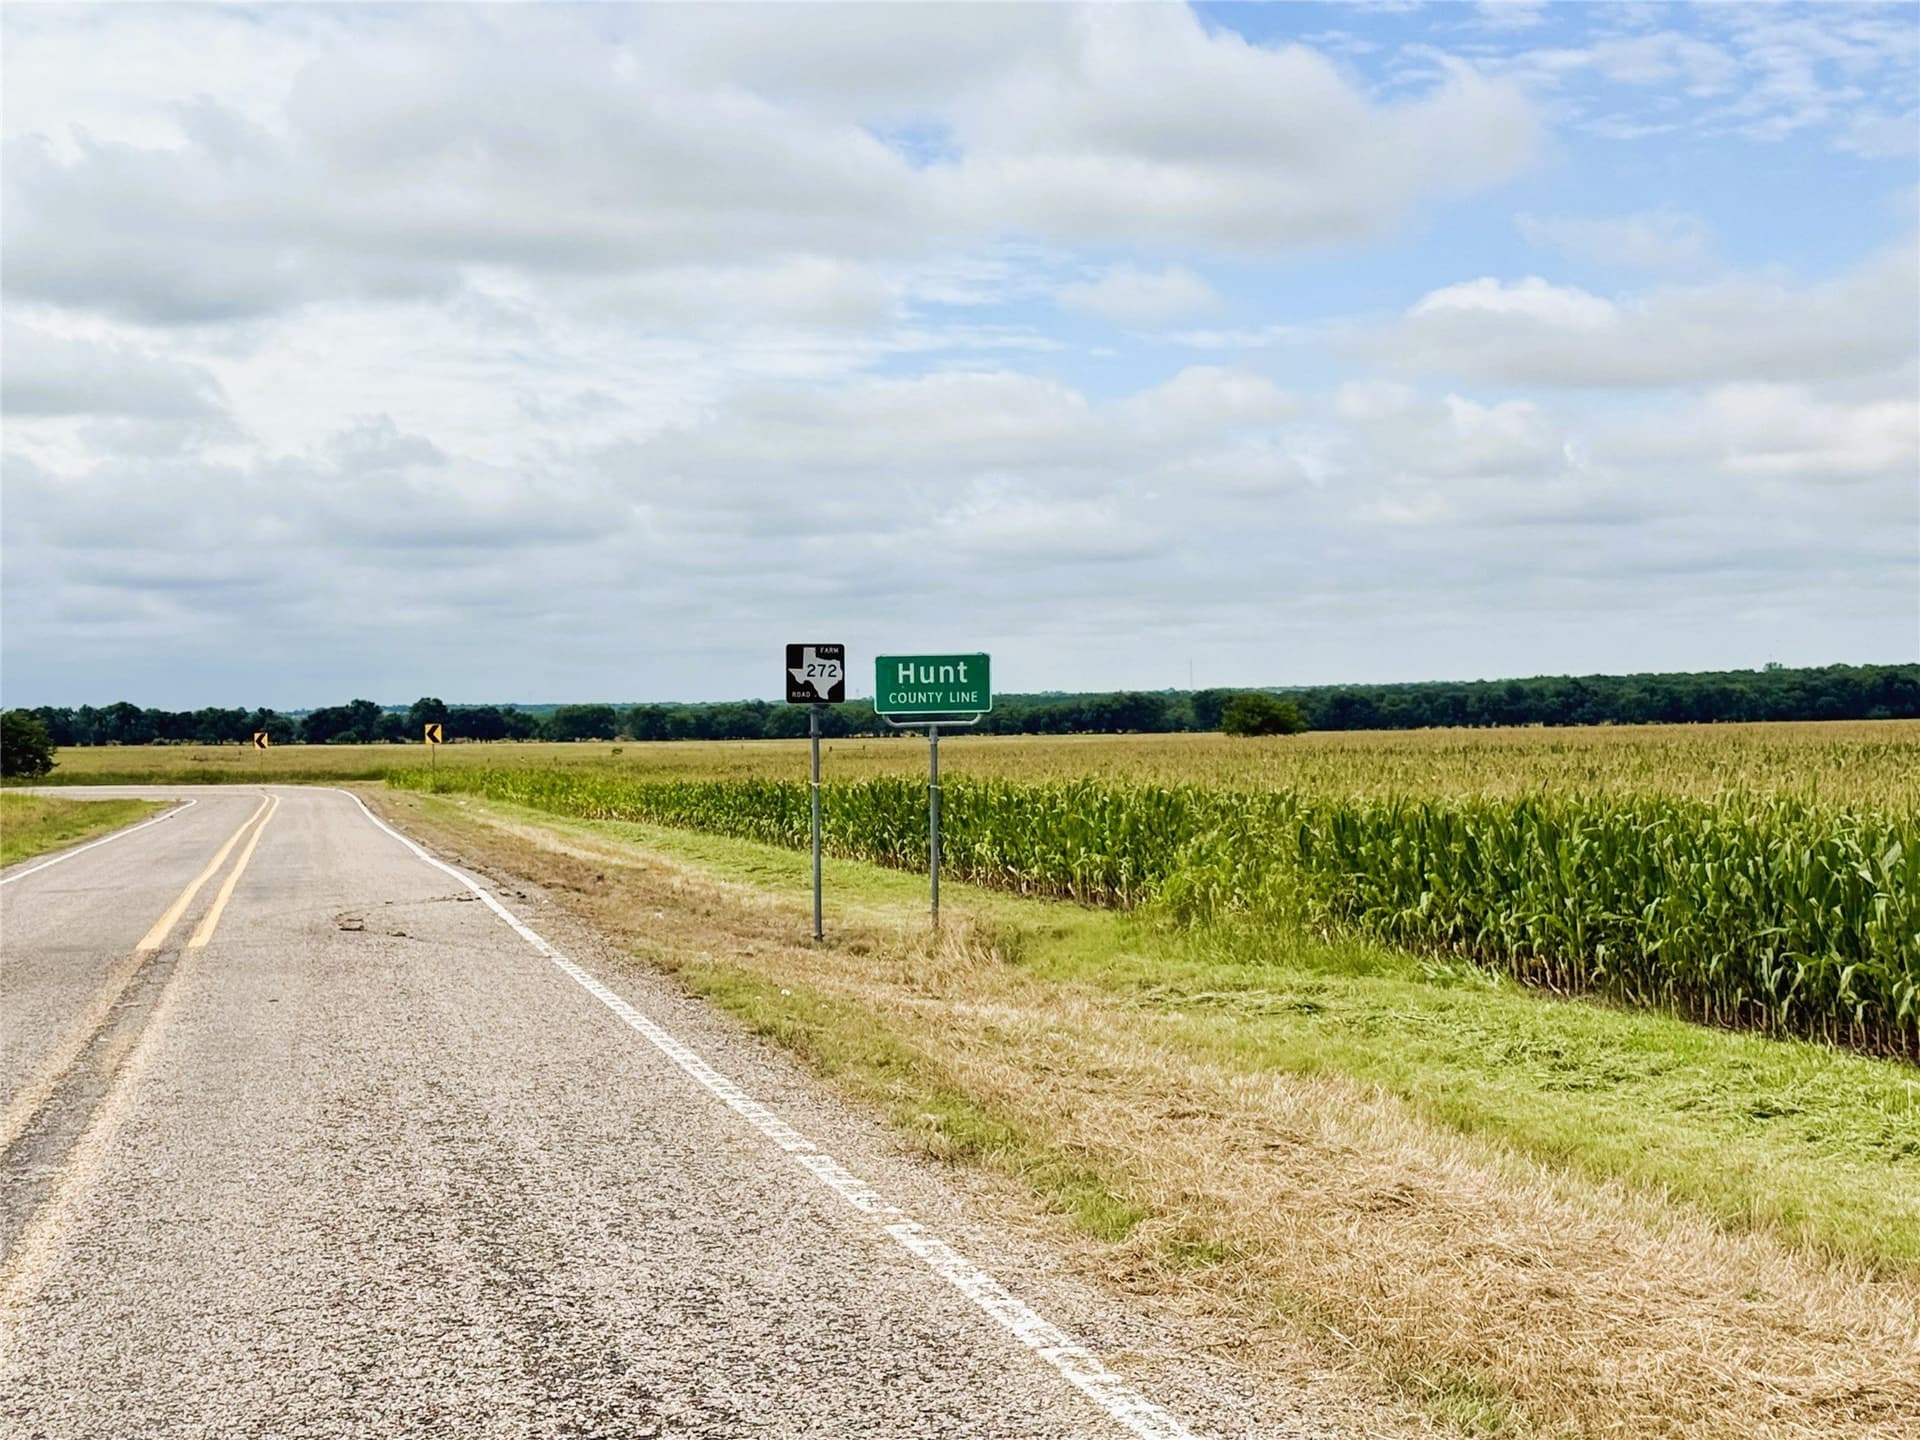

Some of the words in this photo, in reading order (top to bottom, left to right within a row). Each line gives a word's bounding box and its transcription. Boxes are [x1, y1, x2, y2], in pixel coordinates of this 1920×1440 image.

[806, 663, 837, 678] 272
[898, 661, 968, 684] Hunt
[888, 692, 943, 704] COUNTY
[949, 691, 979, 703] LINE
